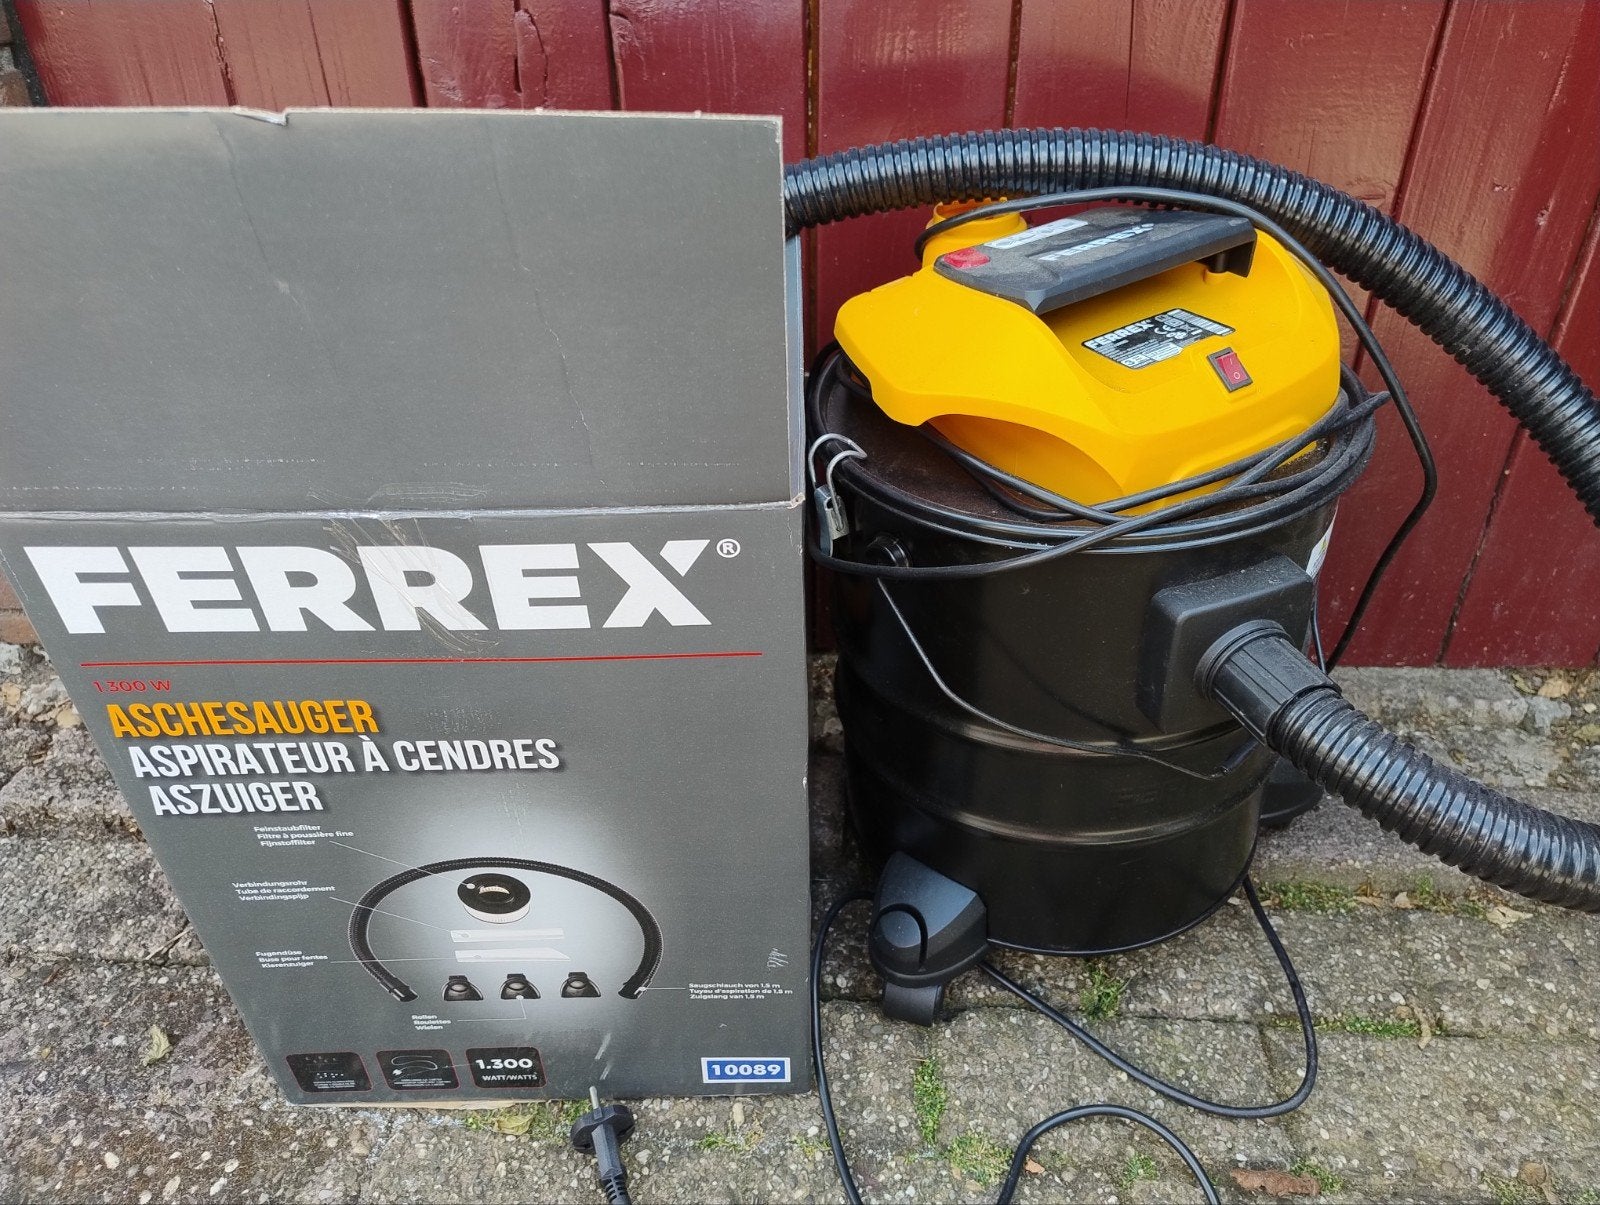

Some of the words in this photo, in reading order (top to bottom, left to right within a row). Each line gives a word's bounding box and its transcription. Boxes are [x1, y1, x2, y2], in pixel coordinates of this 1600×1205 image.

[149, 679, 171, 692] W
[106, 699, 380, 738] ASCHESAUGER
[128, 740, 355, 778] ASPIRATEUR
[363, 735, 390, 772] À
[397, 738, 560, 771] CENDRES
[147, 781, 324, 816] ASZUIGER
[290, 831, 335, 839] poussière
[260, 839, 316, 847] Fijnstoffilter
[231, 880, 308, 888] Verbindungsrohr
[273, 885, 336, 893] raccordement
[238, 893, 310, 901] Verbindingspijp
[475, 1058, 533, 1070] 1.300
[711, 1064, 781, 1076] 10089
[481, 1073, 538, 1081] WATT/WATTS
